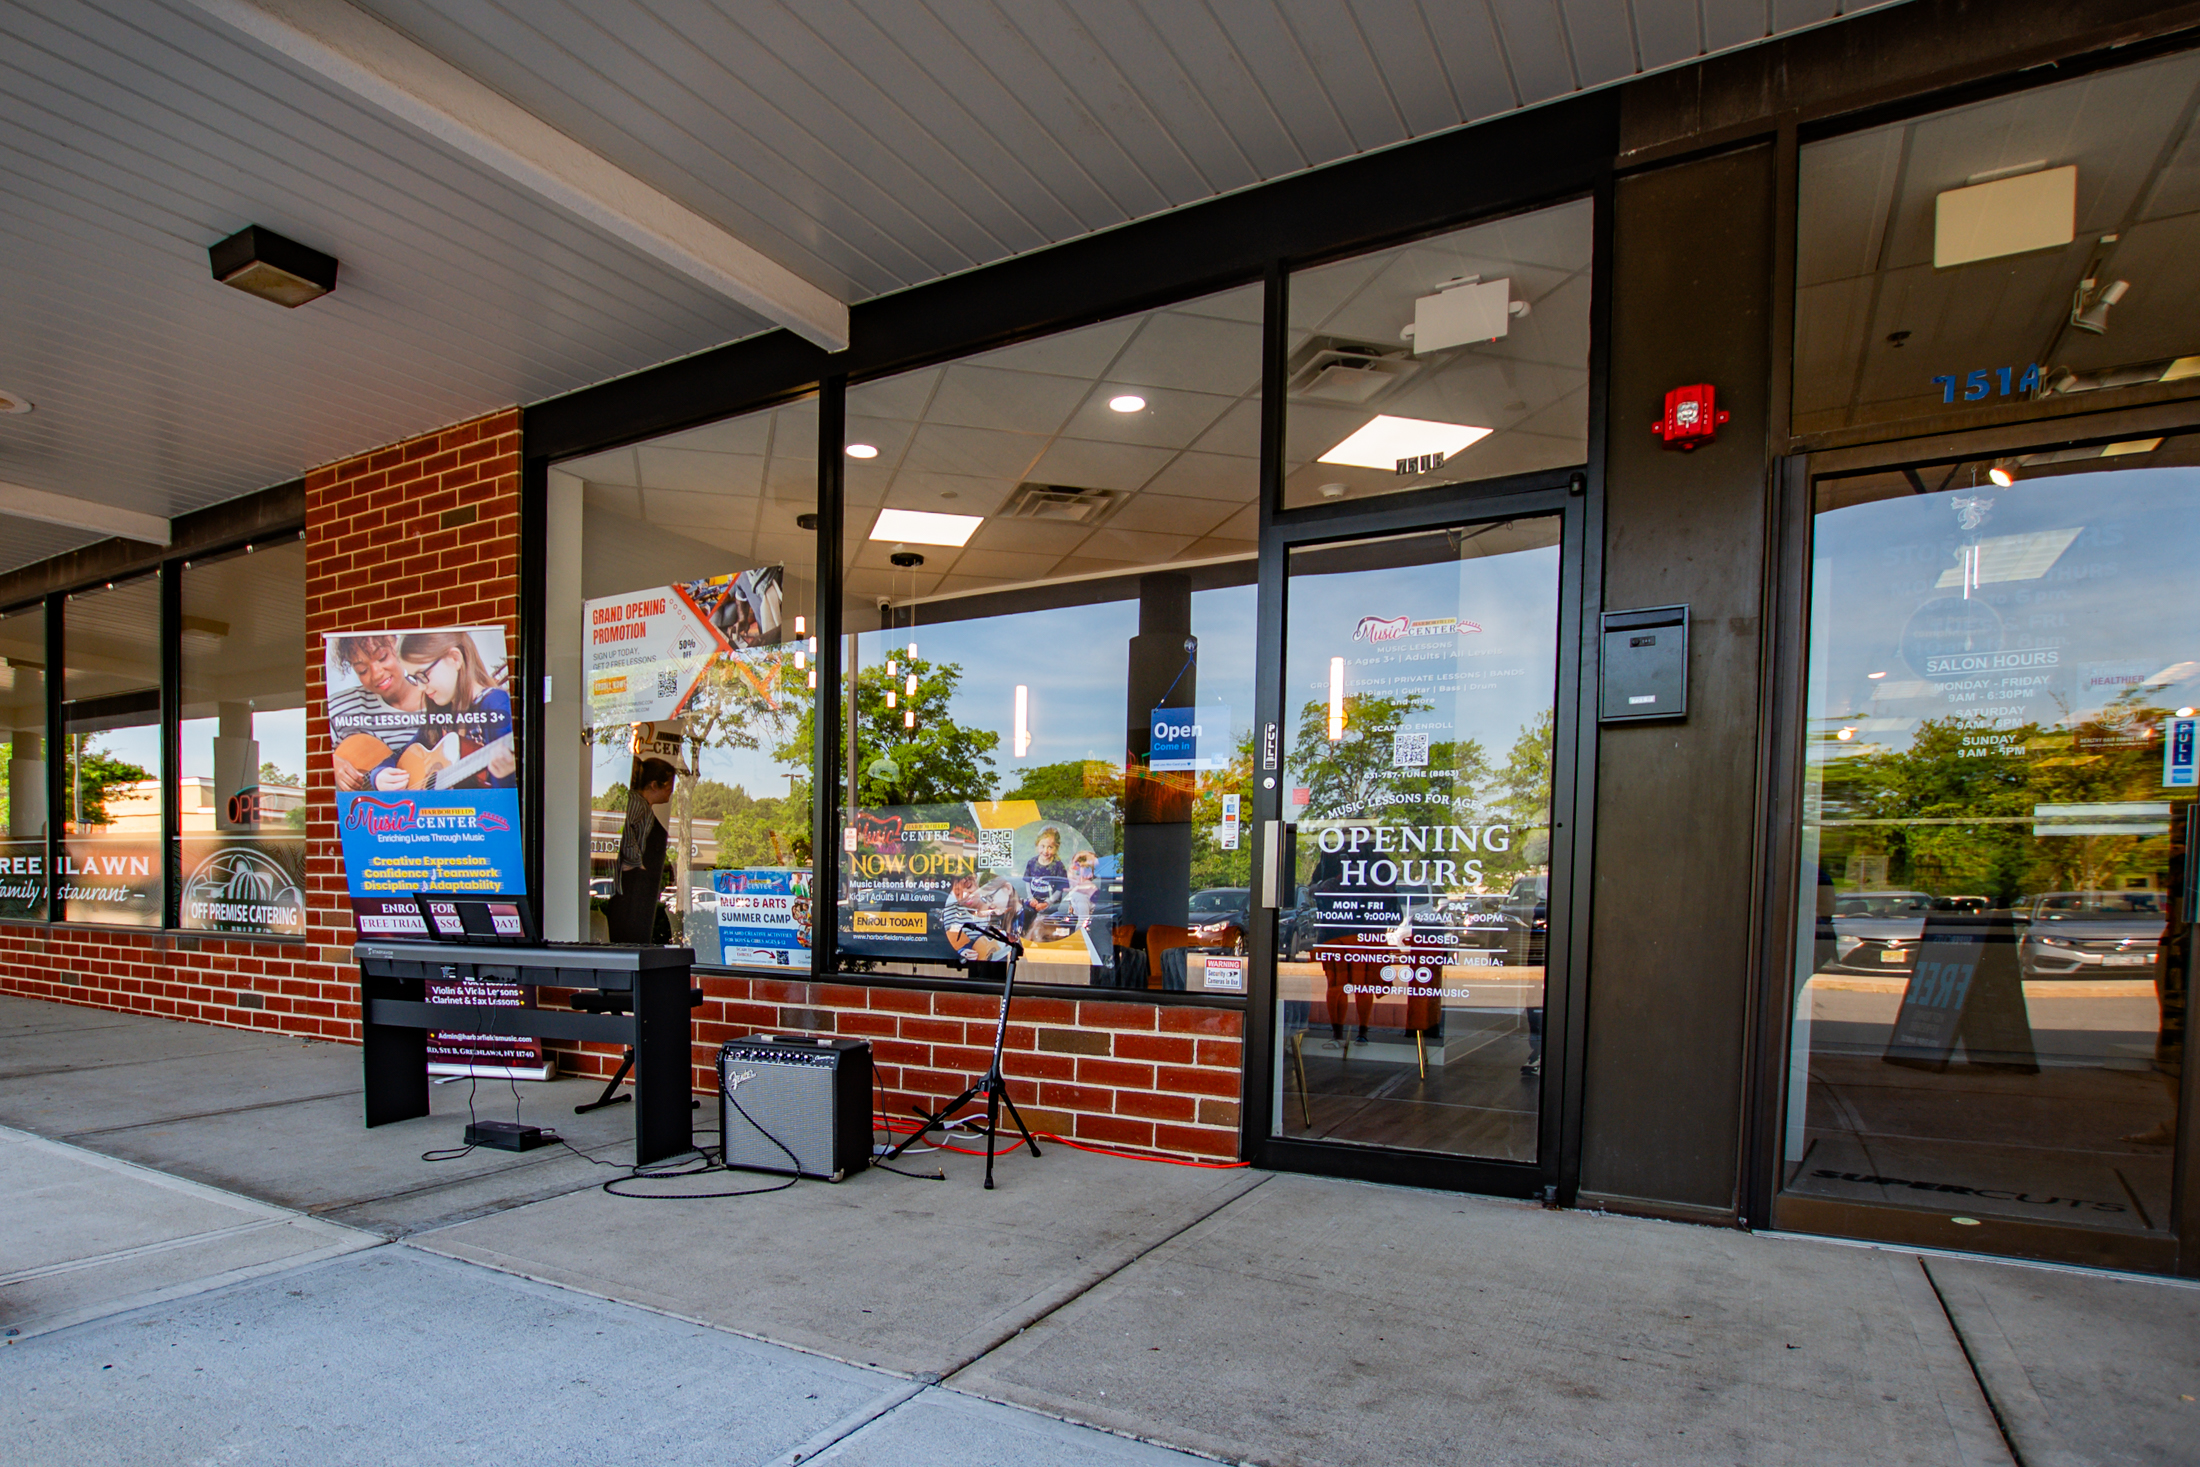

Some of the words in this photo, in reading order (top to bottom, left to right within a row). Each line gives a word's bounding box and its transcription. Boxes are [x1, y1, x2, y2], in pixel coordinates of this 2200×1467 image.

[1930, 363, 2039, 403] 751A
[1397, 452, 1444, 475] 751B
[593, 605, 623, 625] GRAND
[625, 598, 666, 620] OPENING
[593, 621, 647, 645] PROMOTION
[1352, 622, 1401, 644] Music
[1408, 625, 1457, 636] CENTER
[679, 638, 696, 650] 50%
[1377, 645, 1407, 653] MUSIC
[1409, 641, 1453, 651] LESSONS
[593, 651, 608, 661] SIGN
[608, 650, 619, 658] UP
[618, 647, 640, 657] TODAY,
[683, 651, 692, 659] OFF
[1355, 656, 1381, 667] Ages
[1383, 655, 1395, 663] 3+
[1405, 651, 1441, 661] Adults
[1450, 650, 1464, 658] All
[1468, 647, 1504, 657] Levels
[606, 661, 610, 669] 2
[610, 659, 626, 667] FREE
[626, 655, 657, 666] LESSONS
[1926, 657, 1988, 672] SALON
[1993, 651, 2059, 668] HOURS
[1345, 677, 1386, 687] LESSONS
[1394, 674, 1434, 684] PRIVATE
[1437, 671, 1481, 681] LESSONS
[1490, 668, 1525, 677] BANDS
[1934, 680, 1990, 691] MONDAY
[2001, 675, 2051, 687] FRIDAY
[2090, 675, 2145, 686] HEALTHIER
[1368, 688, 1393, 697] Piano
[1401, 686, 1431, 695] Guitar
[1439, 684, 1461, 693] Bass
[1470, 682, 1497, 690] Drum
[1410, 697, 1436, 705] more
[1948, 692, 1975, 703] 9AM
[1987, 689, 2034, 700] 6:30PM
[1955, 705, 2027, 718] SATURDAY
[334, 715, 373, 727] MUSIC
[374, 713, 427, 726] LESSONS
[429, 713, 454, 724] FOR
[456, 712, 487, 724] AGES
[490, 711, 505, 723] 3+
[1956, 720, 1984, 730] 9AM
[1995, 718, 2023, 728] 6PM
[1154, 722, 1203, 742] Open
[1371, 724, 1397, 732] SCAN
[1400, 723, 1412, 731] TO
[1415, 722, 1453, 730] ENROLL
[1267, 724, 1276, 756] PULL
[1962, 734, 2017, 746] SUNDAY
[2178, 723, 2190, 763] PULL
[1154, 742, 1179, 751] Come
[1181, 742, 1190, 750] in
[1999, 746, 2026, 756] 5PM
[1364, 770, 1427, 780] 631-757-TUNE
[1429, 769, 1460, 778] (8863)
[228, 795, 275, 824] OPEN
[1327, 800, 1365, 820] MUSIC
[1367, 793, 1422, 808] LESSONS
[1425, 793, 1450, 805] FOR
[1452, 796, 1485, 811] AGES
[346, 804, 407, 835] Music
[416, 816, 477, 829] CENTER
[378, 834, 411, 844] Enriching
[411, 834, 431, 843] Lives
[431, 833, 461, 843] Through
[462, 833, 485, 843] Music
[901, 830, 951, 841] CENTER
[1318, 824, 1511, 853] OPENING
[373, 856, 422, 867] Creative
[423, 855, 487, 868] Expression
[846, 852, 907, 879] NOW
[908, 853, 975, 876] OPEN
[364, 868, 429, 879] Confidence
[436, 868, 499, 879] Teamwork
[1339, 859, 1483, 887] HOURS
[364, 880, 419, 893] Discipline
[429, 880, 502, 893] Adaptability
[849, 880, 873, 889] Music
[873, 880, 904, 889] Lessons
[905, 880, 916, 889] for
[918, 880, 939, 890] Ages
[940, 880, 951, 889] 3+
[849, 892, 865, 901] Kids
[870, 893, 894, 901] Adults
[899, 893, 910, 901] All
[911, 893, 935, 902] Levels
[430, 903, 456, 914] FOR
[753, 898, 759, 908] &
[762, 898, 787, 909] ARTS
[1333, 901, 1358, 910] MON
[1367, 901, 1384, 910] FRI
[1449, 902, 1469, 911] SAT
[191, 902, 208, 919] OFF
[209, 904, 248, 922] PREMISE
[249, 905, 297, 925] CATERING
[721, 912, 762, 923] SUMMER
[763, 914, 791, 924] CAMP
[1363, 912, 1401, 921] 9:00PM
[1415, 913, 1452, 922] 9:30AM
[362, 918, 390, 928] FREE
[390, 918, 424, 928] TRIAL
[889, 918, 923, 927] TODAY!
[1413, 934, 1459, 944] CLOSED
[1207, 960, 1240, 968] WARNING
[1315, 952, 1341, 962] LET'S
[1344, 953, 1395, 963] CONNECT
[1399, 955, 1416, 964] ON
[1419, 955, 1461, 966] SOCIAL
[1464, 957, 1504, 967] MEDIA:
[1208, 969, 1226, 978] Security
[1207, 977, 1225, 985] Cameras
[432, 986, 456, 995] Violin
[456, 987, 464, 995] &
[1343, 983, 1470, 998] @HARBORFIELDSMUSIC
[432, 995, 463, 1005] Clarinet
[464, 997, 471, 1005] &
[1811, 1169, 2127, 1213] SUPERCUTS
